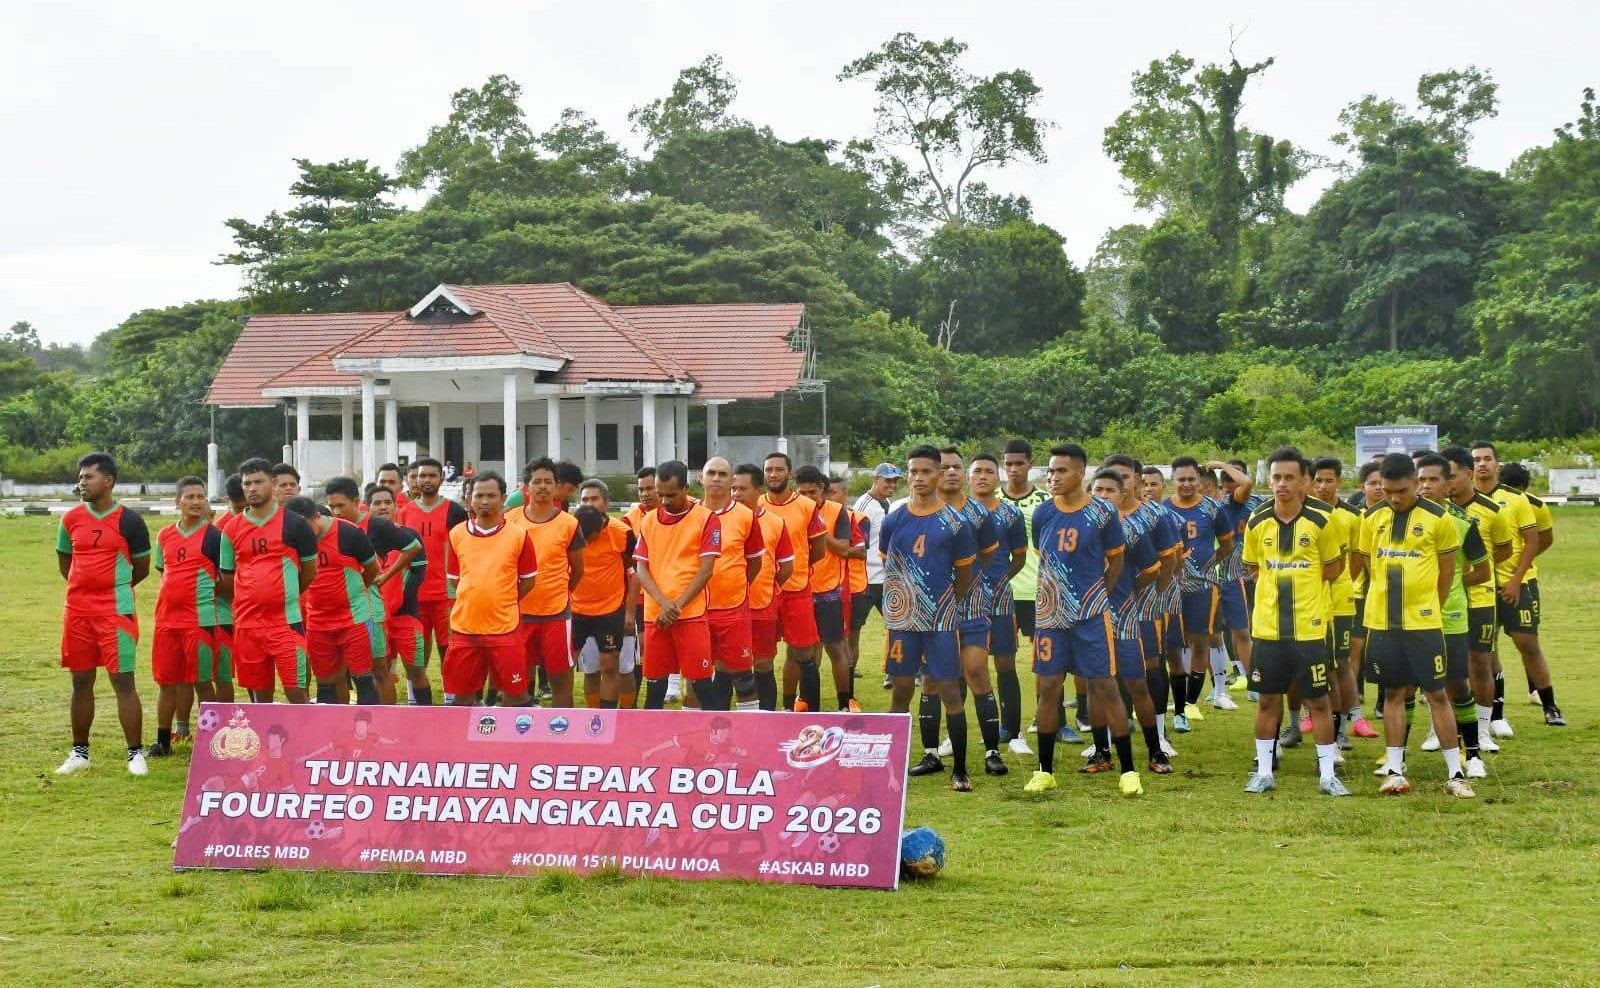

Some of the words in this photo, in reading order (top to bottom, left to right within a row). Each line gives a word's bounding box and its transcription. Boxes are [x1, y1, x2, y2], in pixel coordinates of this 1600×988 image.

[421, 521, 432, 537] 11
[92, 530, 102, 547] 7
[251, 538, 268, 555] 18
[913, 534, 926, 558] 4
[1057, 528, 1079, 553] 13
[177, 547, 186, 562] 8
[1519, 609, 1532, 624] 10
[1343, 630, 1350, 646] 9
[1481, 624, 1493, 640] 17
[890, 640, 904, 664] 4
[1434, 654, 1443, 673] 8
[1311, 663, 1327, 682] 12
[304, 760, 518, 789] TURNAMEN
[528, 764, 657, 794] SEPAK
[668, 768, 776, 796] BOLA
[199, 790, 374, 820] FOURFEO
[384, 795, 679, 829] BHAYANGKARA
[691, 802, 775, 831] CUP
[785, 805, 882, 835] 2026
[203, 844, 271, 859] #POLRES
[274, 846, 310, 860] MBD
[360, 848, 426, 863] #PEMDA
[429, 849, 467, 864] MBD
[511, 852, 577, 867] #KODIM
[582, 854, 617, 869] 1511
[621, 855, 677, 871] PULAU
[681, 857, 721, 872] MOA
[758, 860, 825, 876] #ASKAB
[829, 862, 870, 877] MBD
